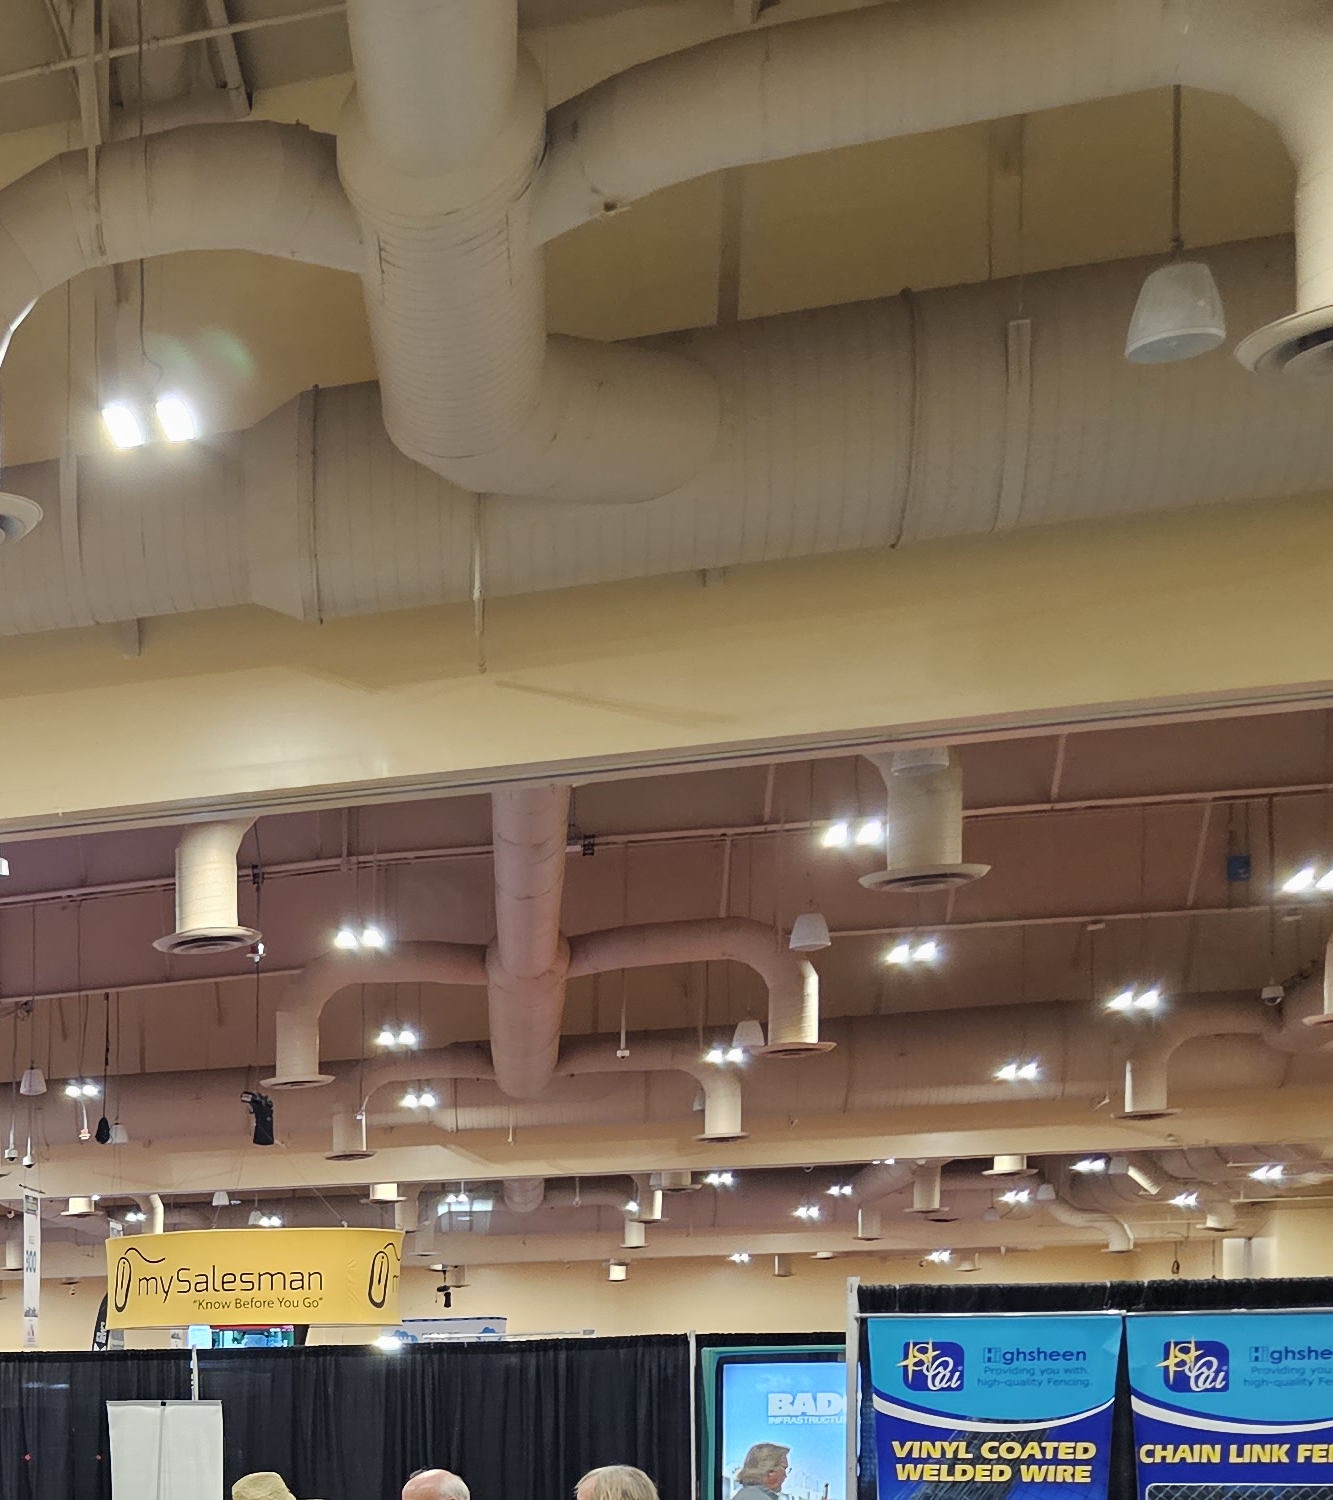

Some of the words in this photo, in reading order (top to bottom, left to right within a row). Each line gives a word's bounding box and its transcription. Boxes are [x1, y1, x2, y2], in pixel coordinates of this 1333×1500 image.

[138, 1265, 323, 1303] mySalesman
[235, 1298, 275, 1309] Before
[277, 1297, 299, 1308] You
[985, 1366, 1035, 1377] Providing
[1040, 1368, 1060, 1377] you
[1064, 1366, 1088, 1375] with
[1251, 1366, 1306, 1377] Providing
[977, 1378, 1044, 1388] high-quality
[1244, 1378, 1314, 1388] high-quality
[768, 1393, 847, 1416] BAD
[768, 1416, 847, 1425] INFRASTRUCTU
[892, 1441, 974, 1459] VINYL
[980, 1441, 1097, 1460] COATED
[1139, 1444, 1222, 1464] CHAIN
[1228, 1444, 1290, 1464] LINK
[896, 1464, 1012, 1482] WELDED
[1020, 1465, 1092, 1483] WIRE
